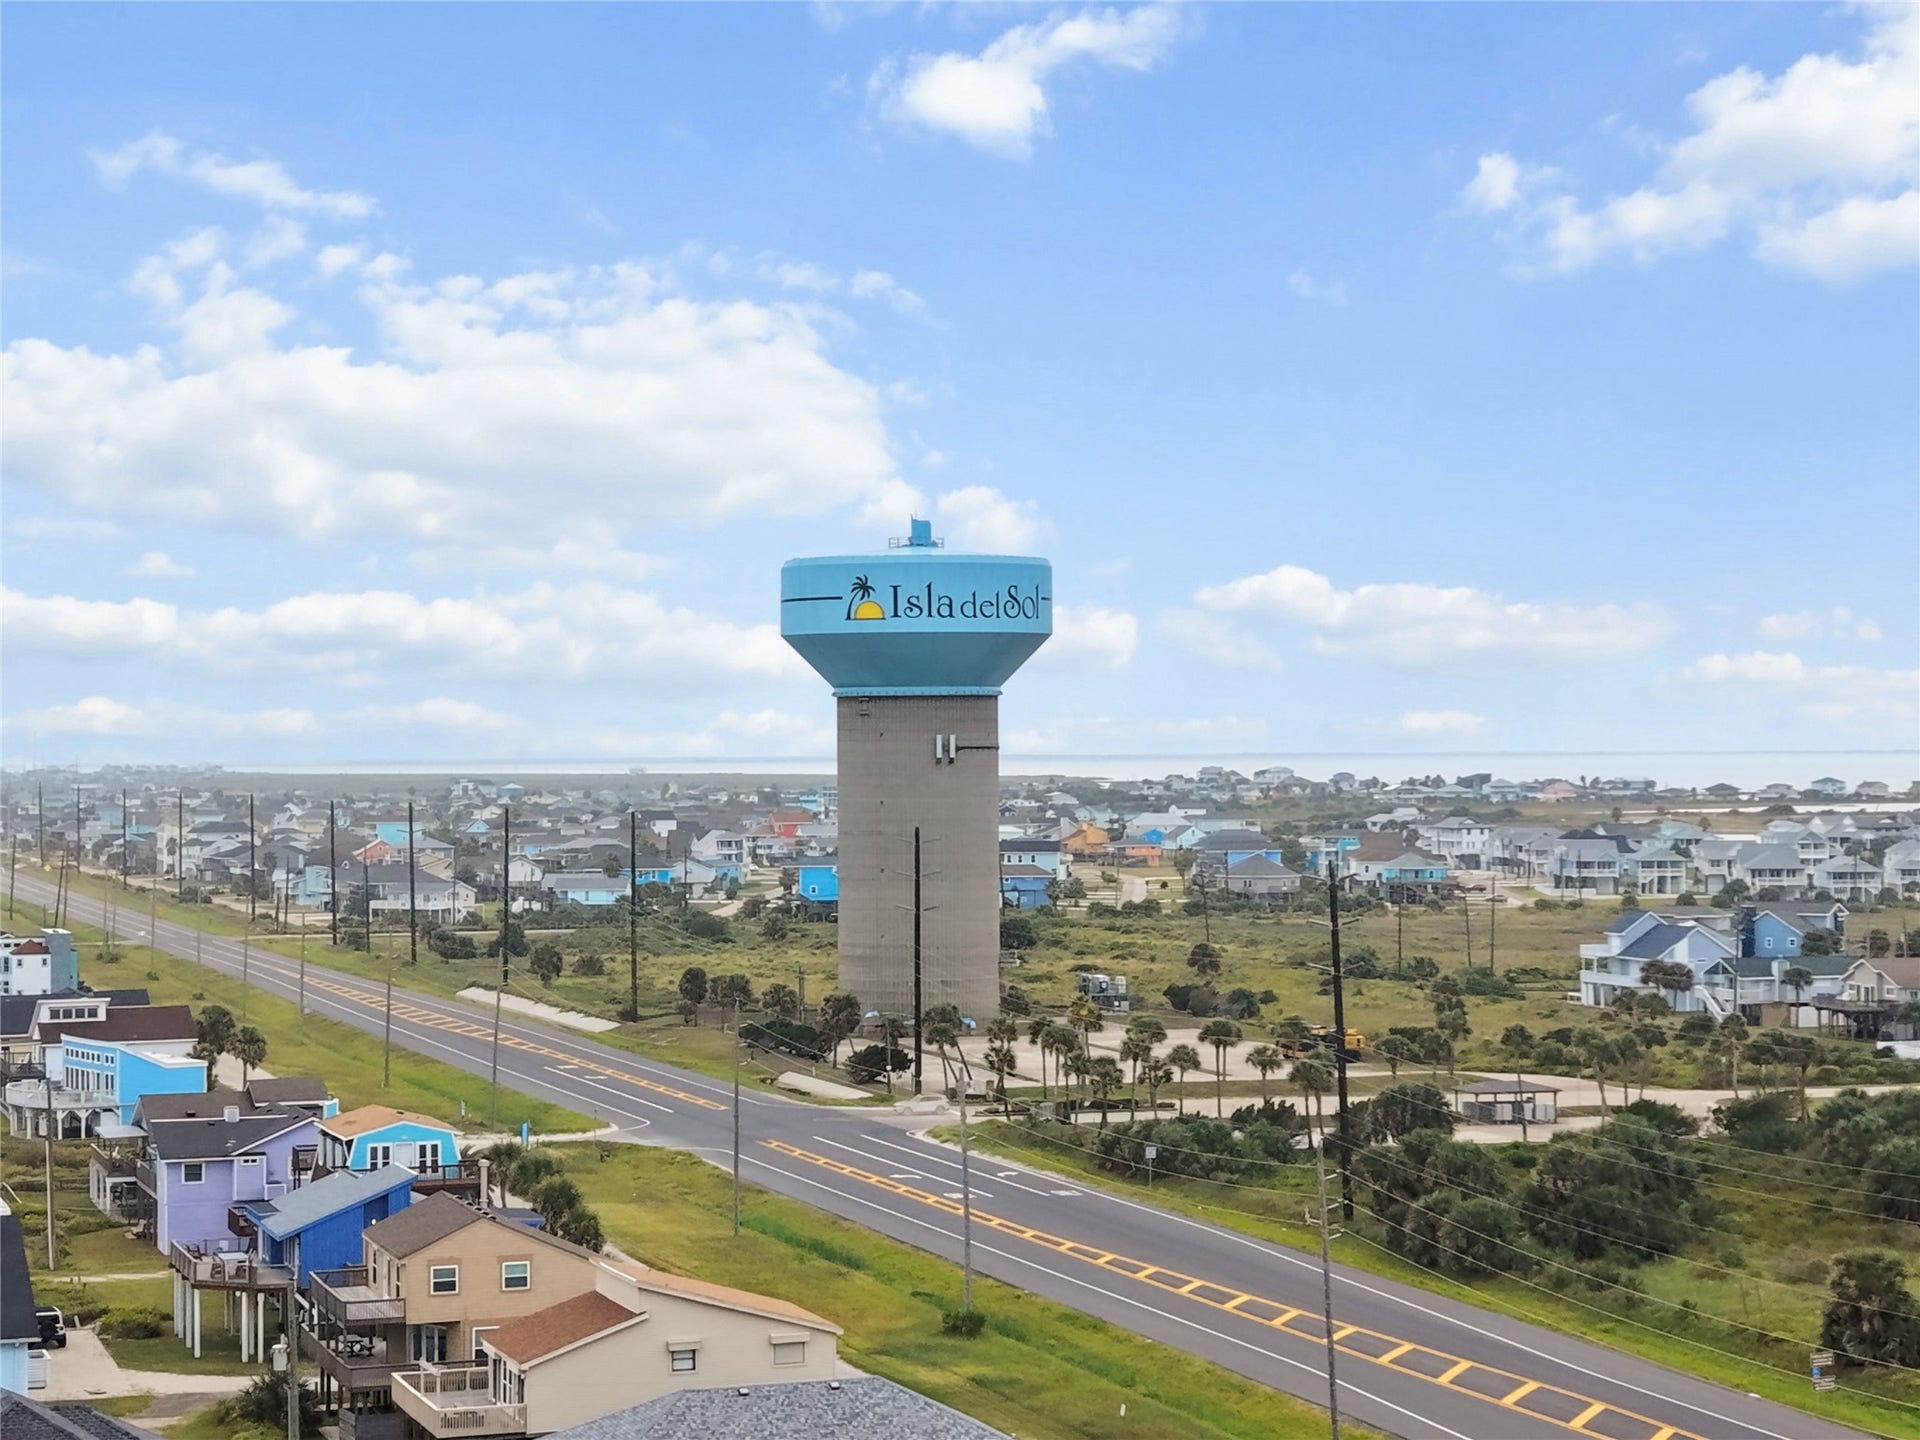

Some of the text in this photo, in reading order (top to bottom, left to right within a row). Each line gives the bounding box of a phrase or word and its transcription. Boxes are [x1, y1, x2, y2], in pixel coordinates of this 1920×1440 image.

[889, 581, 1039, 619] Isla del Sol
